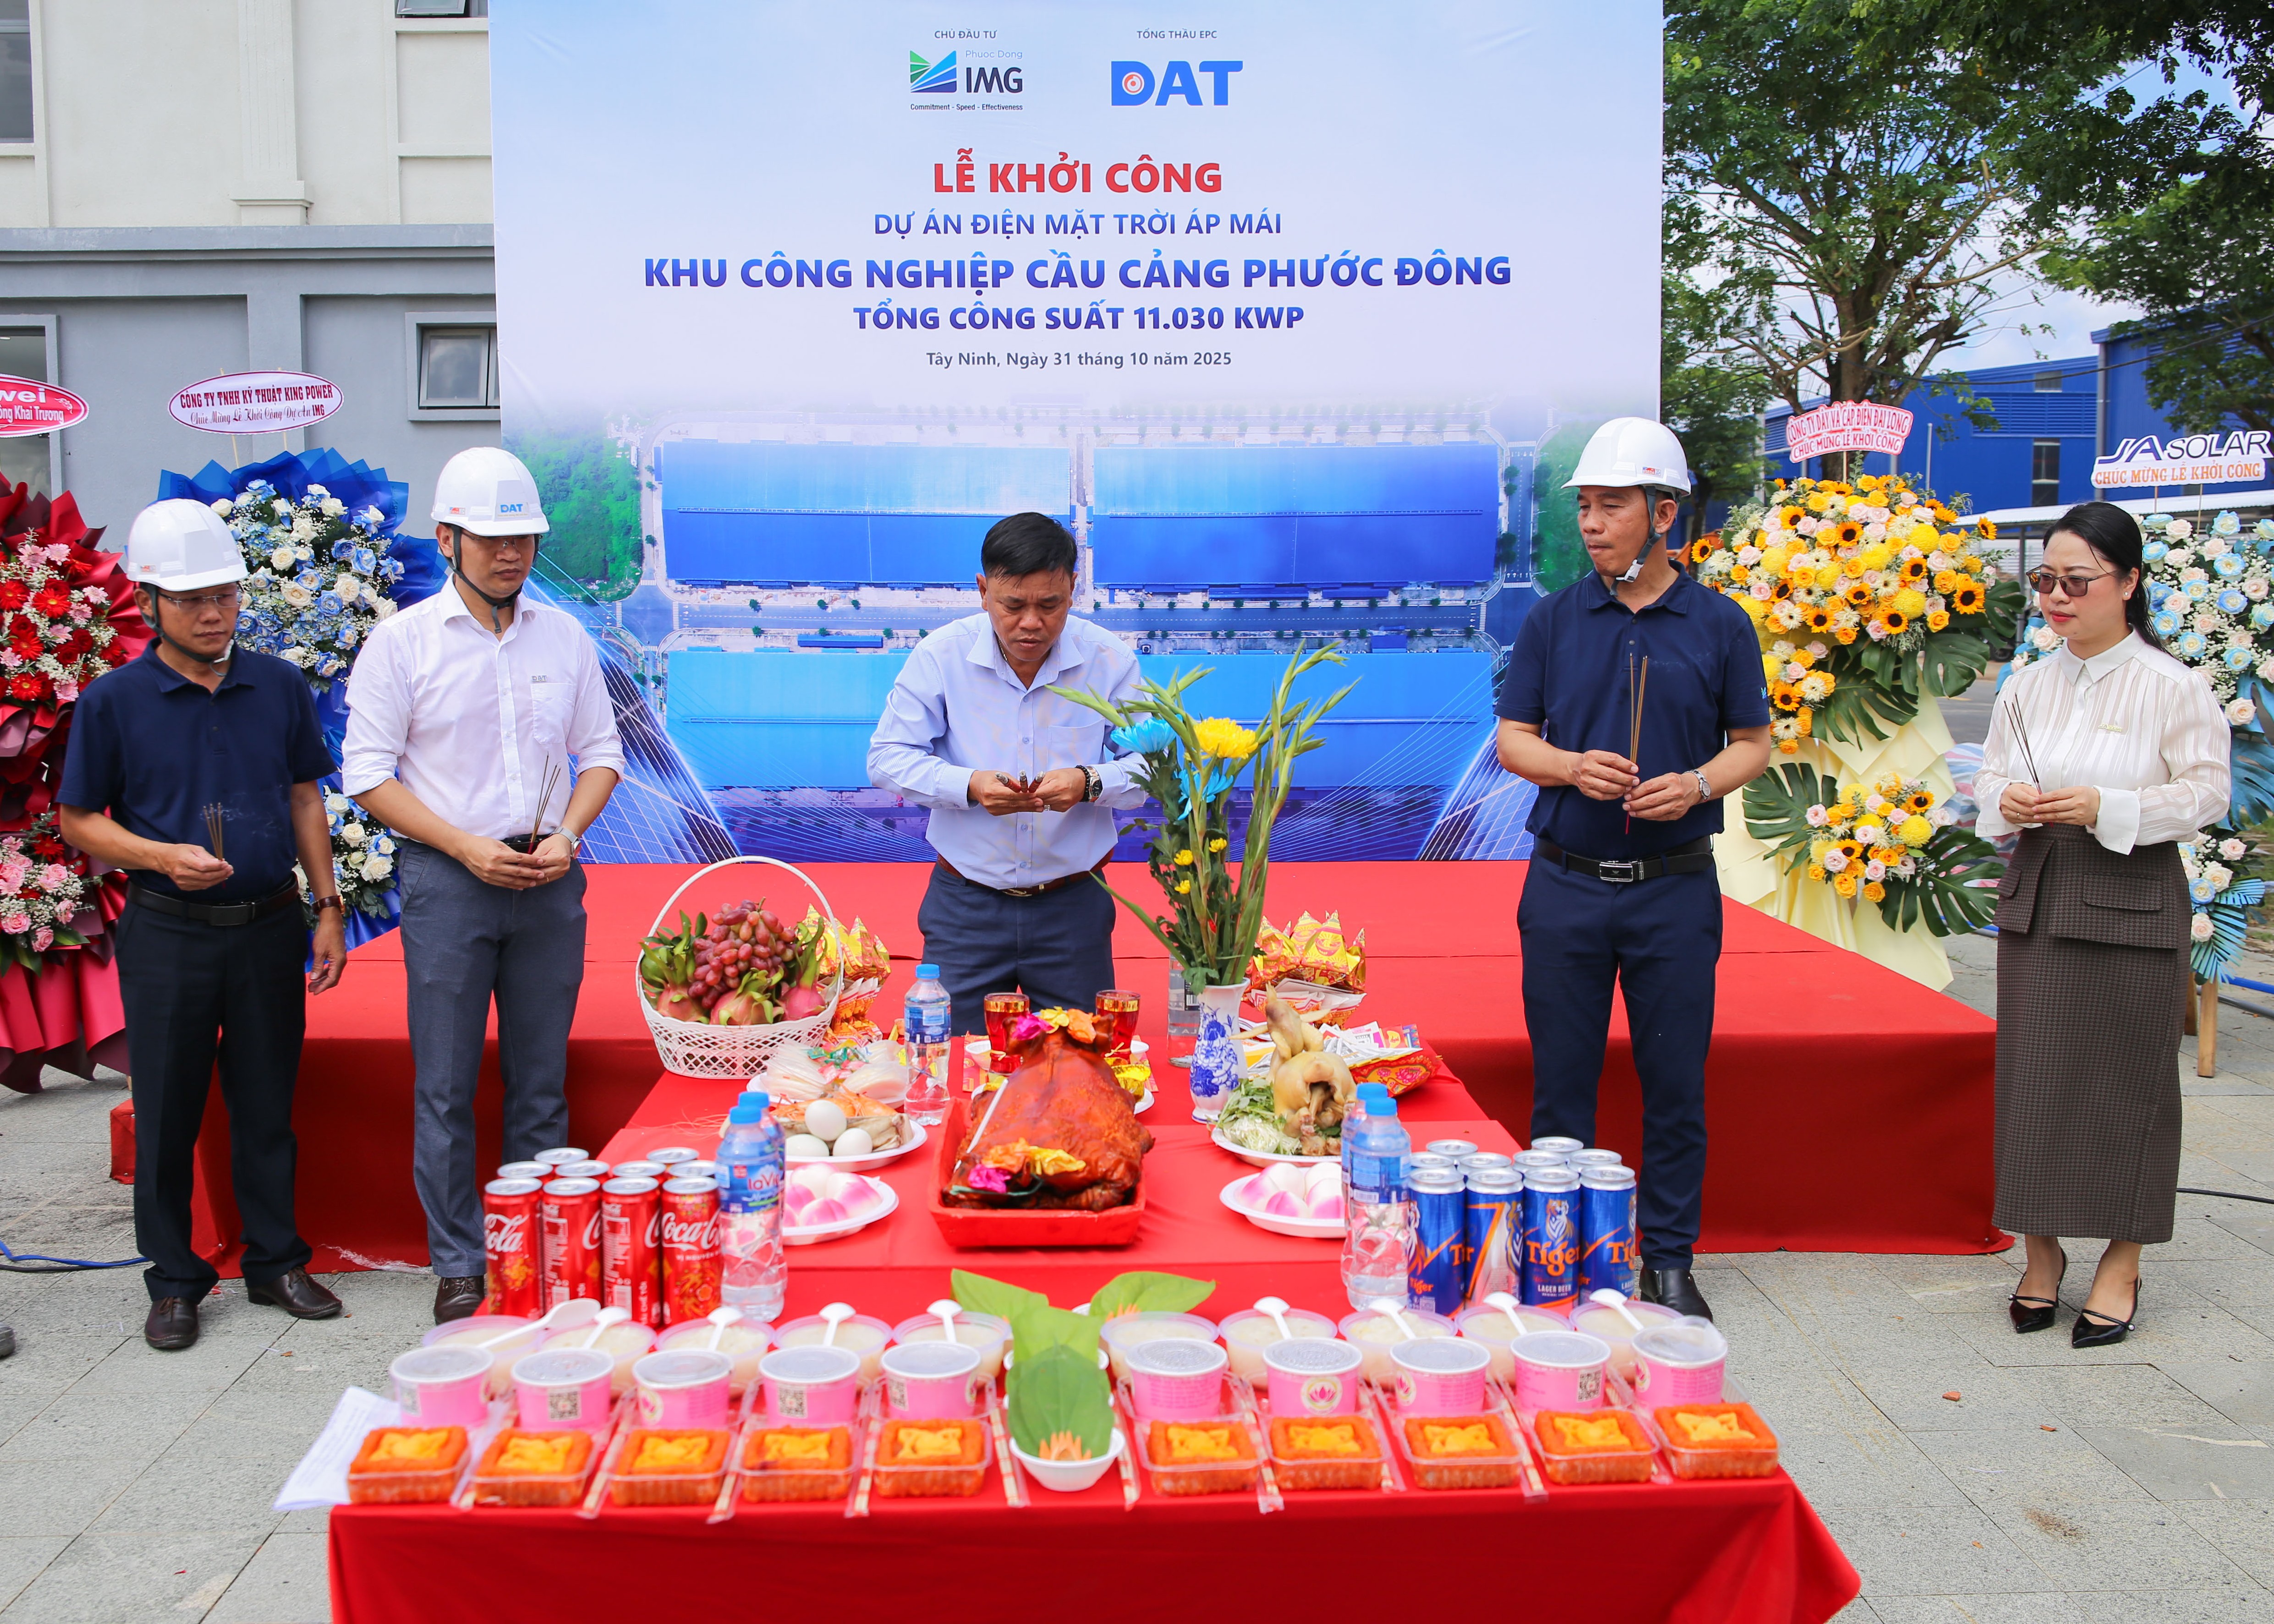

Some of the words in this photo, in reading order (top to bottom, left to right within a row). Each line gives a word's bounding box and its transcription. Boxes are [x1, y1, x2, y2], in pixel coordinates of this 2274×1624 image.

[934, 28, 955, 39] CHỦ
[958, 28, 980, 39] ĐẦU
[983, 29, 997, 39] TƯ
[1137, 27, 1166, 39] TỔNG
[1168, 28, 1196, 39] THẦU
[1200, 30, 1217, 39] EPC
[998, 50, 1023, 59] Dong
[966, 66, 1023, 94] IMG
[1111, 60, 1244, 106] DAT
[956, 104, 975, 112] Speed
[934, 148, 975, 193] LỄ
[989, 151, 1091, 193] KHỞI
[1105, 154, 1222, 193] CÔNG
[874, 210, 915, 240] DỰ
[922, 208, 962, 235] ÁN
[970, 208, 1035, 240] ĐIỆN
[1045, 208, 1105, 240] MẶT
[1112, 208, 1175, 235] TRỜI
[1184, 208, 1221, 235] ÁP
[1230, 207, 1281, 234] MÁI
[645, 258, 727, 288] KHU
[740, 250, 852, 289] CÔNG
[866, 251, 1014, 296] NGHIỆP
[1026, 249, 1105, 289] CẦU
[1118, 248, 1229, 289] CẢNG
[1244, 249, 1383, 288] PHƯỚC
[1394, 248, 1511, 286] ĐÔNG
[853, 297, 940, 330] TỔNG
[949, 300, 1036, 330] CÔNG
[1045, 299, 1124, 330] SUẤT
[1134, 306, 1224, 330] 11.030
[1234, 306, 1304, 329] KWP
[926, 351, 953, 369] Tây
[959, 352, 1000, 367] Ninh,
[1007, 352, 1048, 369] Ngày
[1053, 352, 1070, 366] 31
[1077, 351, 1123, 369] tháng
[1130, 352, 1148, 366] 10
[1154, 352, 1188, 366] năm
[1194, 352, 1232, 365] 2025
[180, 390, 202, 408] CÔNG
[204, 392, 214, 406] TY
[217, 390, 241, 406] TNHH
[255, 384, 282, 405] THUẬT
[285, 386, 304, 401] KING
[305, 385, 333, 399] POWER
[14, 405, 33, 420] Khai
[191, 412, 208, 425] Chúc
[210, 410, 230, 425] Mừng
[244, 407, 263, 421] Khởi
[264, 407, 282, 421] Công
[284, 405, 296, 421] Dự
[298, 401, 311, 417] Án
[312, 404, 325, 416] IMG
[1788, 419, 1807, 443] CÔNG
[1807, 415, 1816, 434] TY
[1843, 404, 1855, 426] CÁP
[1887, 411, 1909, 433] LONG
[1794, 440, 1814, 458] CHÚC
[1816, 434, 1841, 451] MỪNG
[1843, 429, 1850, 446] LỄ
[1853, 429, 1874, 446] KHỞI
[1876, 433, 1900, 451] CÔNG
[2098, 437, 2163, 465] JA
[2167, 432, 2267, 459] SOLAR
[2095, 467, 2127, 485] CHÚC
[2131, 466, 2167, 483] MỪNG
[2171, 461, 2186, 481] LỄ
[2191, 459, 2223, 480] KHỞI
[2227, 460, 2260, 478] CÔNG
[500, 503, 523, 513] DAT
[1538, 1284, 1557, 1293] LAGER
